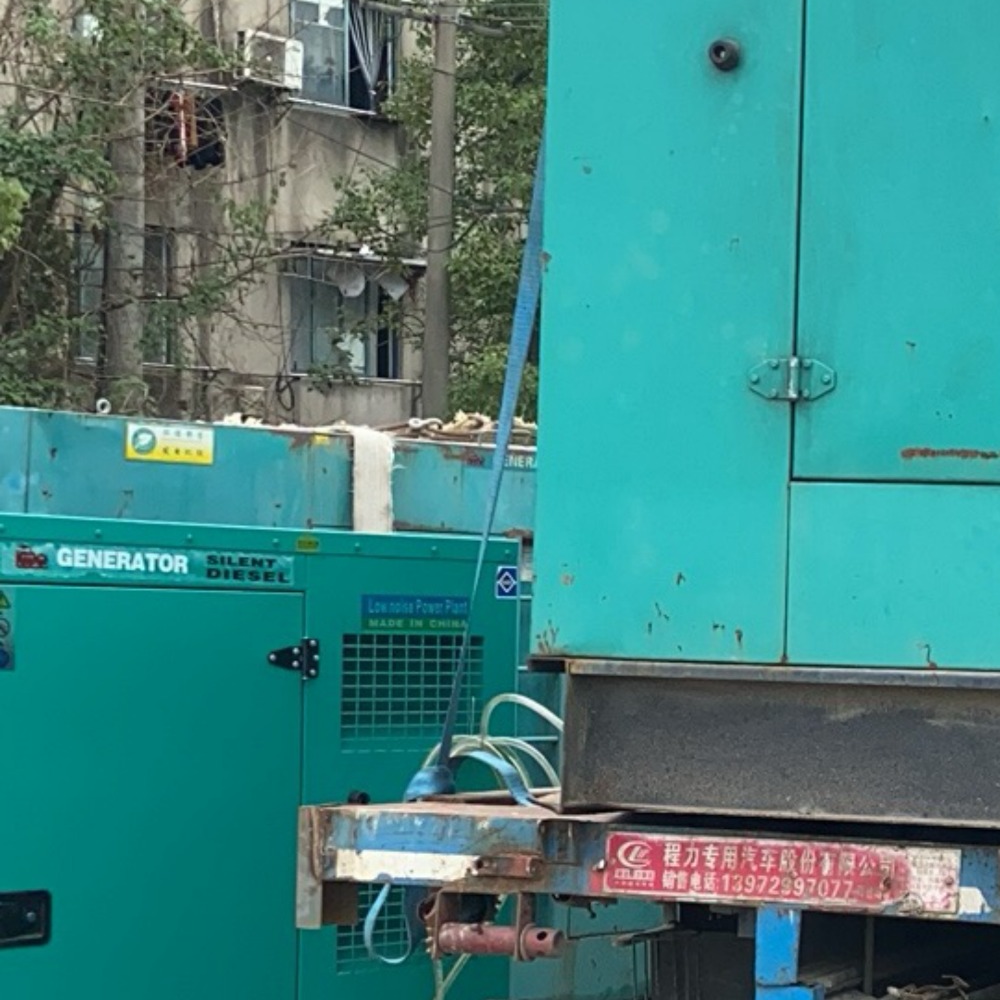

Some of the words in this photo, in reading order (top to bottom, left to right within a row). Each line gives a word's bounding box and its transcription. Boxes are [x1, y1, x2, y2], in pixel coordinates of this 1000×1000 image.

[56, 547, 188, 574] GENERATOR
[206, 554, 277, 569] SILENT
[206, 567, 291, 584] DIESEL
[367, 618, 404, 628] MADE
[410, 618, 423, 628] IN
[428, 618, 467, 629] CHINA
